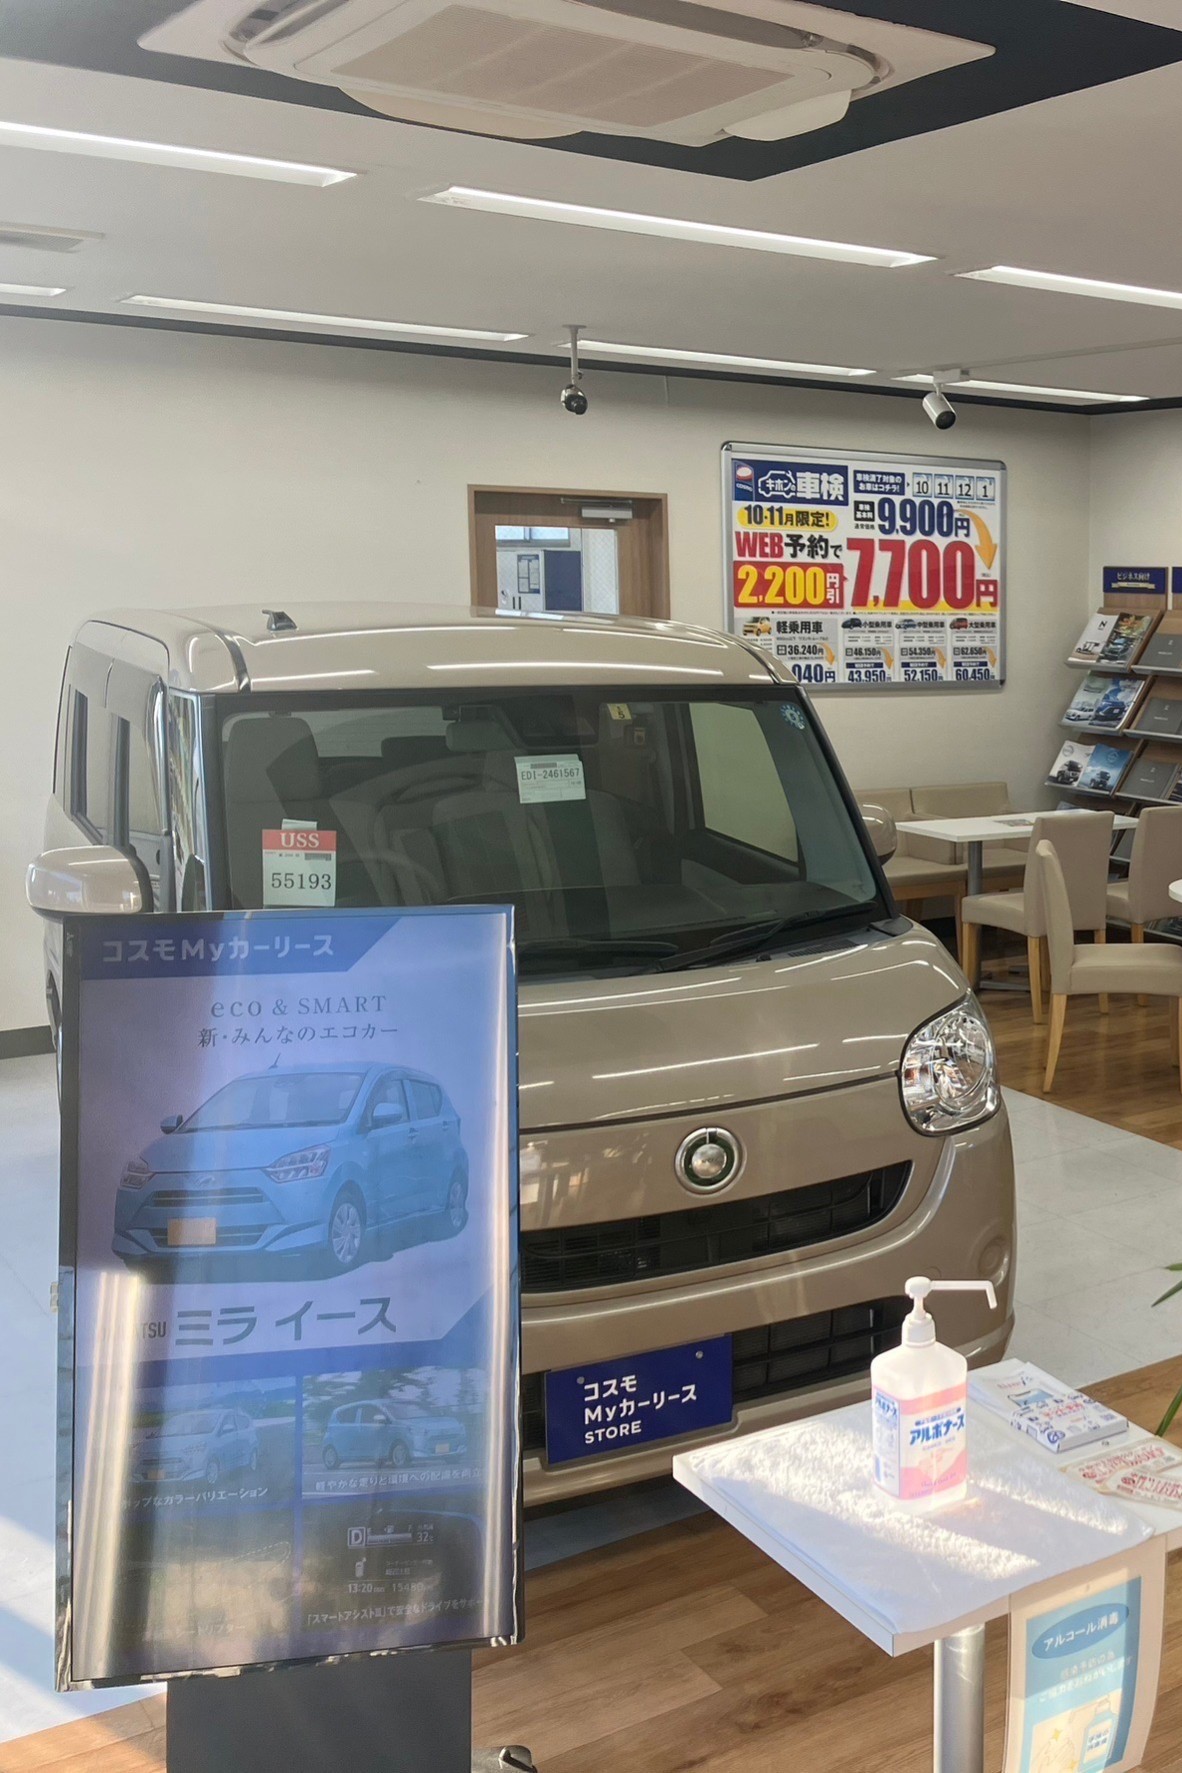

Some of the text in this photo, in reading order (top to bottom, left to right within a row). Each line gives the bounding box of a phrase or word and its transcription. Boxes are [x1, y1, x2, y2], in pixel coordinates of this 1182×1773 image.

[916, 481, 929, 495] 10
[938, 482, 950, 496] 11
[958, 483, 971, 497] 12
[877, 497, 970, 538] 9,900円
[735, 531, 843, 559] WEB予約で
[846, 537, 998, 609] 7,700円
[776, 620, 824, 634] 軽乗用車
[280, 832, 320, 848] USS
[271, 872, 332, 890] 55193
[102, 934, 335, 964] コスモMyカーリース
[210, 995, 387, 1018] eco & SMART
[175, 1305, 258, 1347] ミラ
[275, 1296, 397, 1342] イース
[584, 1375, 638, 1402] コスモ
[584, 1384, 697, 1425] Myカーリース
[584, 1420, 642, 1444] STORE
[910, 1414, 965, 1446] アルボナース
[1043, 1611, 1120, 1652] アルコール消毒
